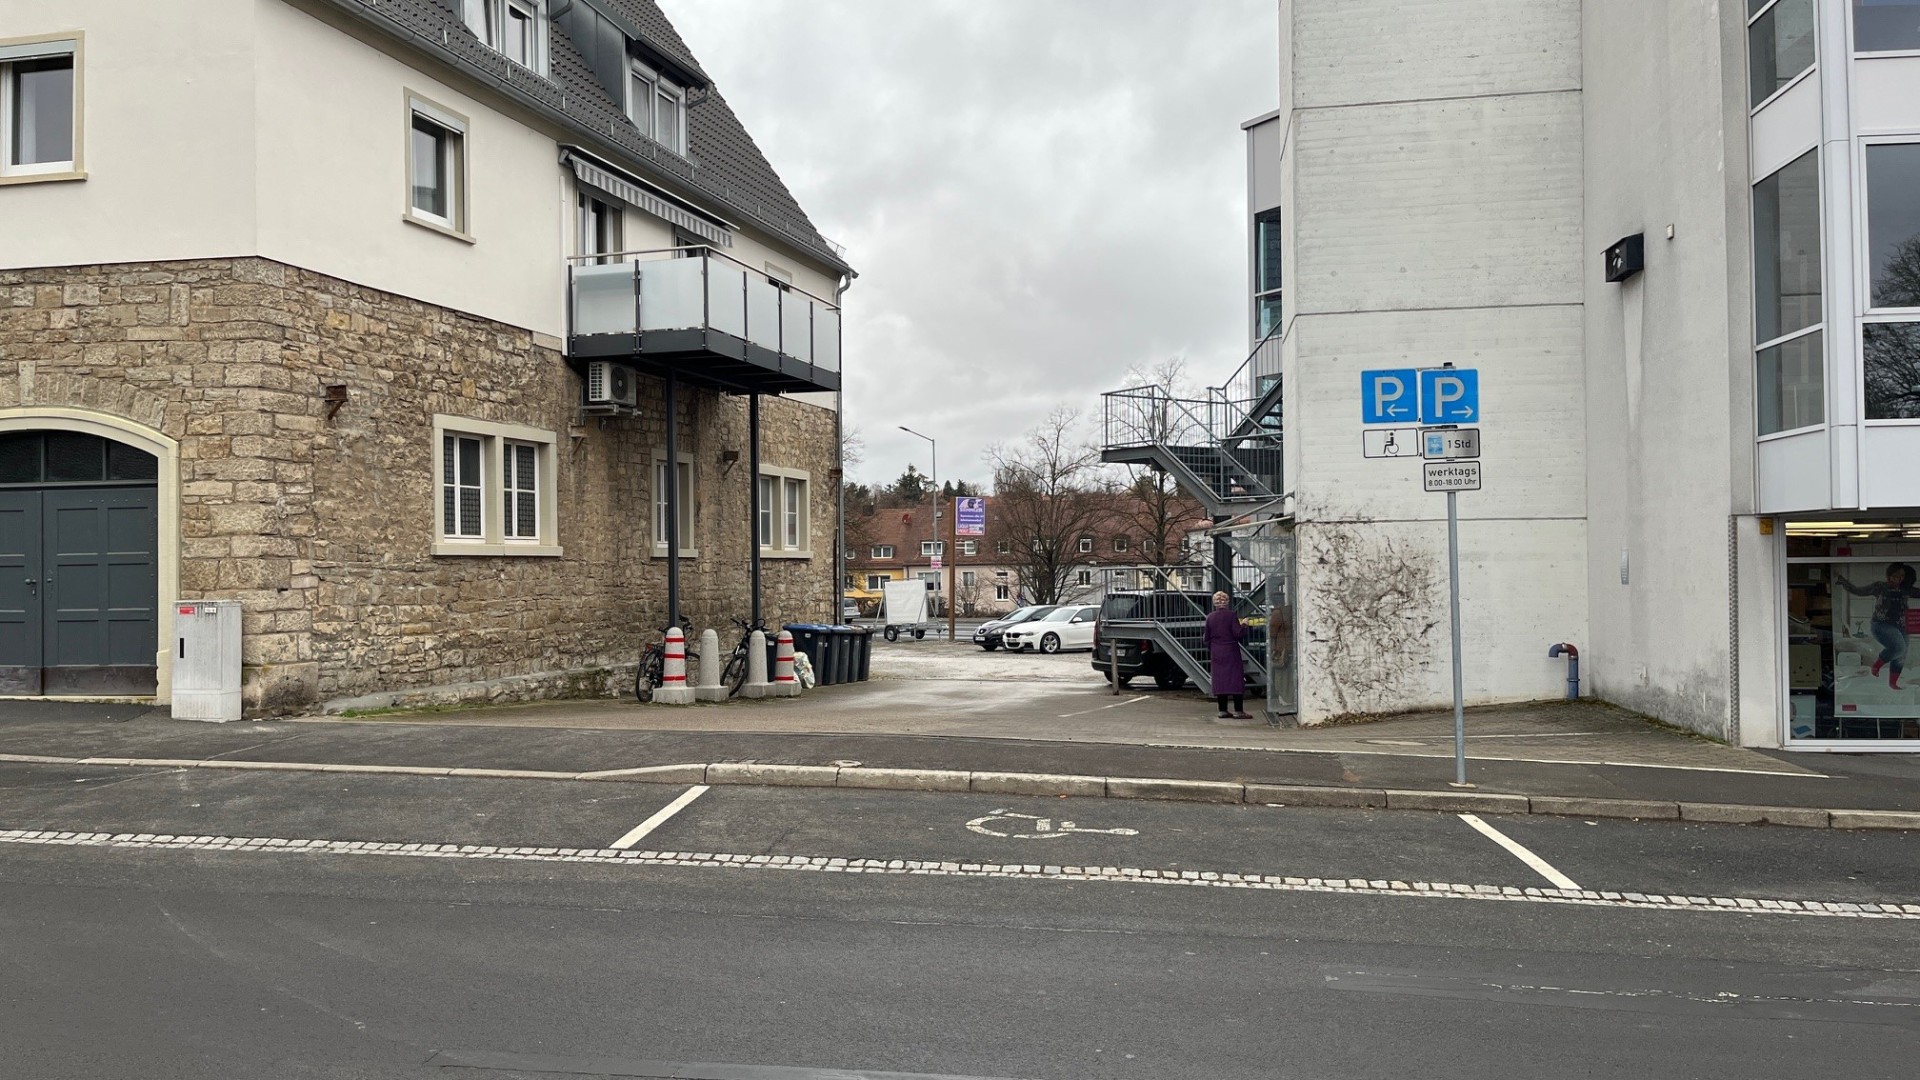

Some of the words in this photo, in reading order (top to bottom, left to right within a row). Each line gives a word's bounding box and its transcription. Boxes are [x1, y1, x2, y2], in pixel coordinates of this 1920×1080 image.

[1374, 376, 1404, 417] P
[1435, 377, 1465, 418] P
[1447, 440, 1452, 449] 1
[1428, 467, 1477, 477] werktags
